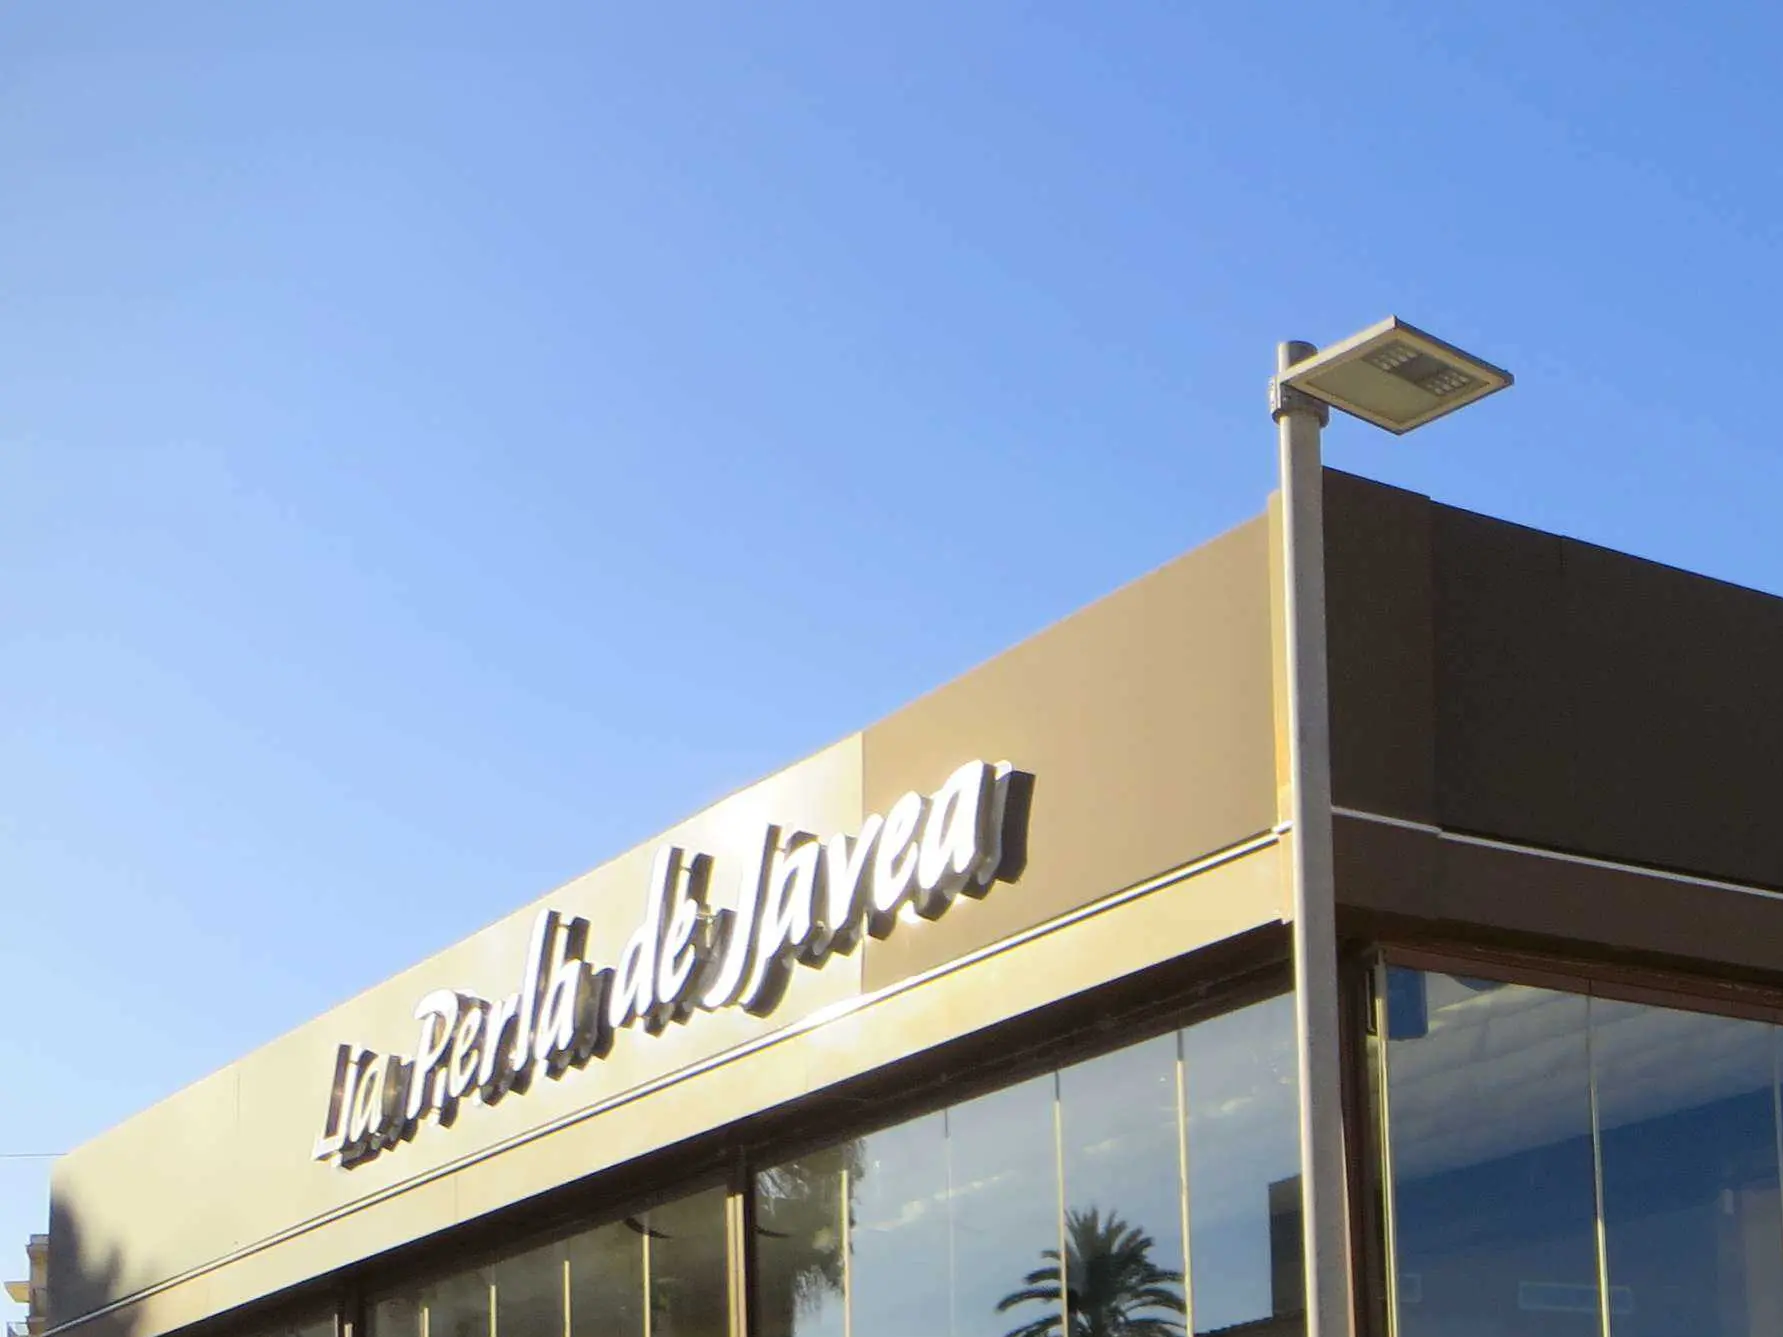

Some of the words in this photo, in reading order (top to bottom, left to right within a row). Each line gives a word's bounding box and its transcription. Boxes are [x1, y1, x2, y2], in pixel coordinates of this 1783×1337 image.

[312, 1043, 392, 1161] La
[405, 907, 592, 1120] Perla
[608, 842, 707, 1028] de
[702, 758, 1014, 1010] Javea
